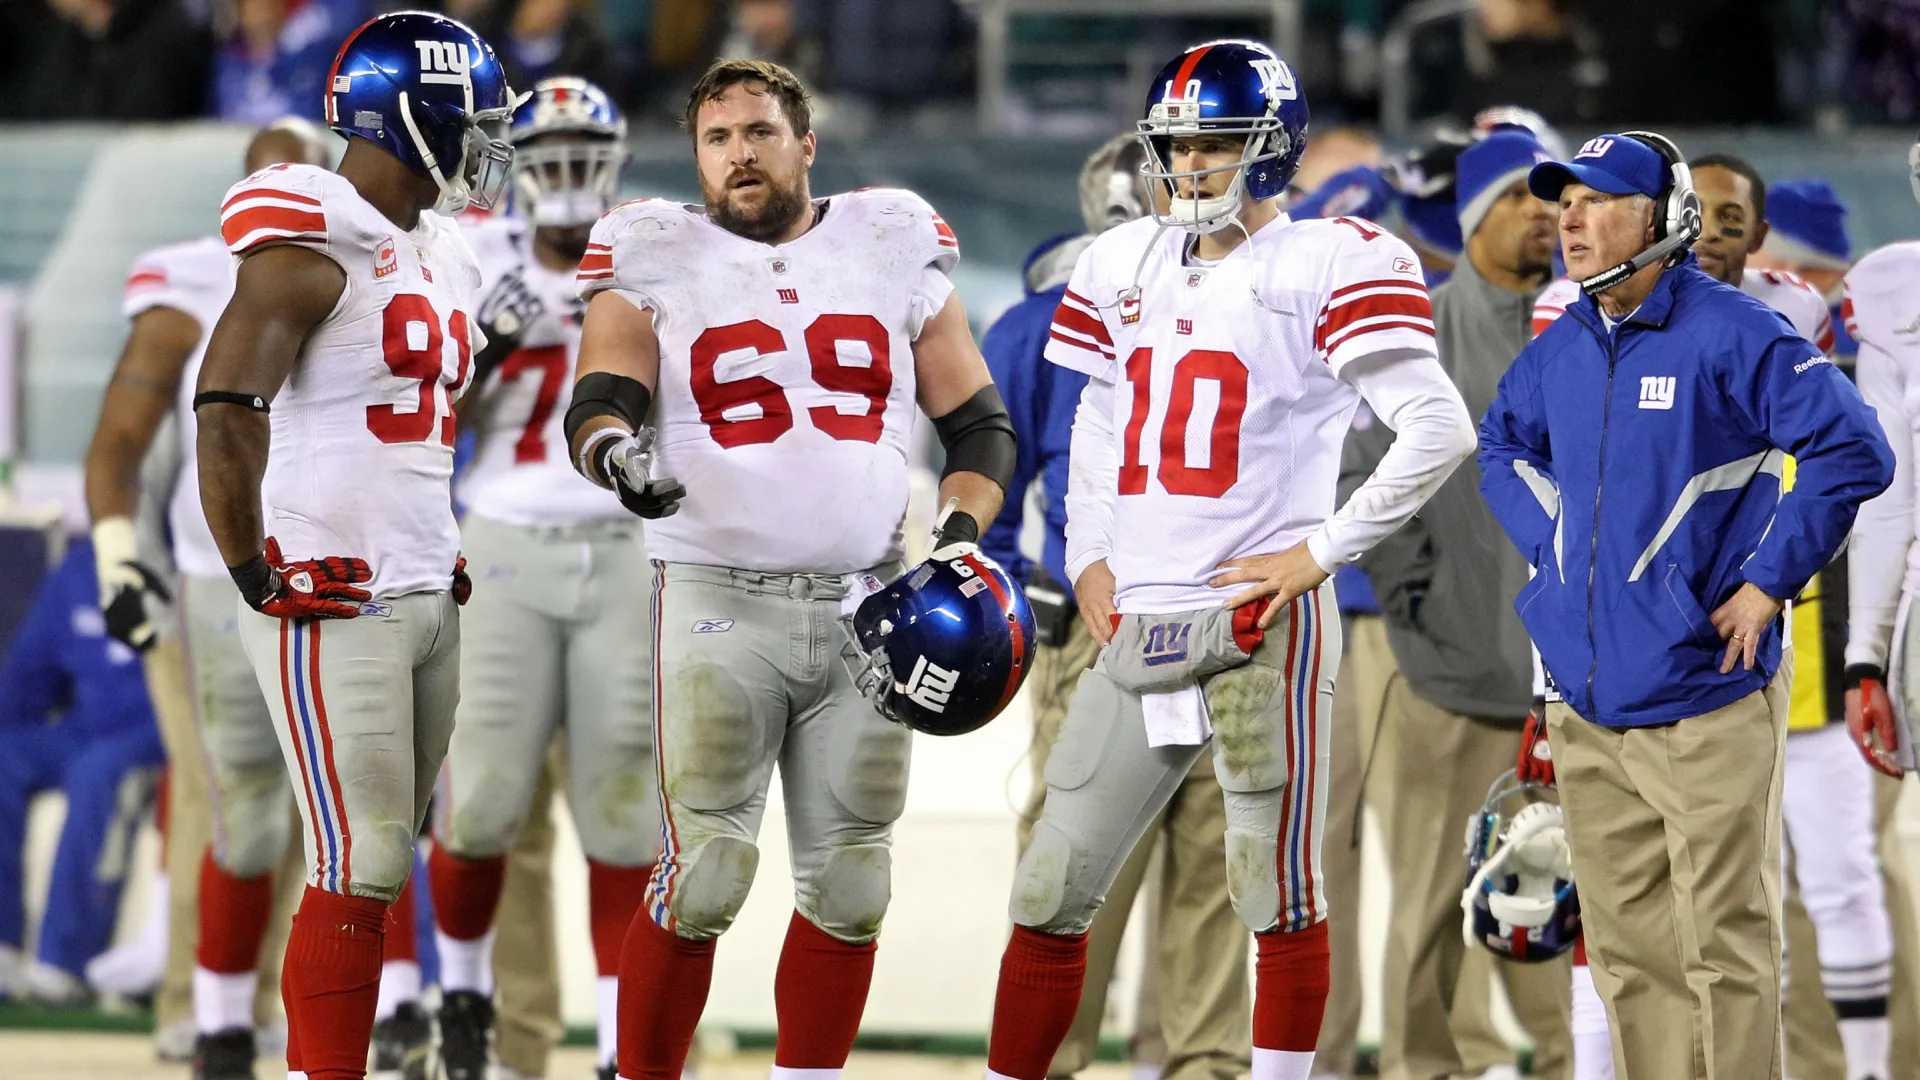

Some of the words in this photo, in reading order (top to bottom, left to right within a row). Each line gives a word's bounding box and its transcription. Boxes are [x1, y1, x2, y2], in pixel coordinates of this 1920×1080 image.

[1162, 79, 1201, 104] 10
[1333, 217, 1384, 242] 1
[1582, 263, 1628, 288] MOTOROLA
[366, 293, 471, 447] 91
[690, 313, 893, 449] 69
[1117, 346, 1249, 498] 10
